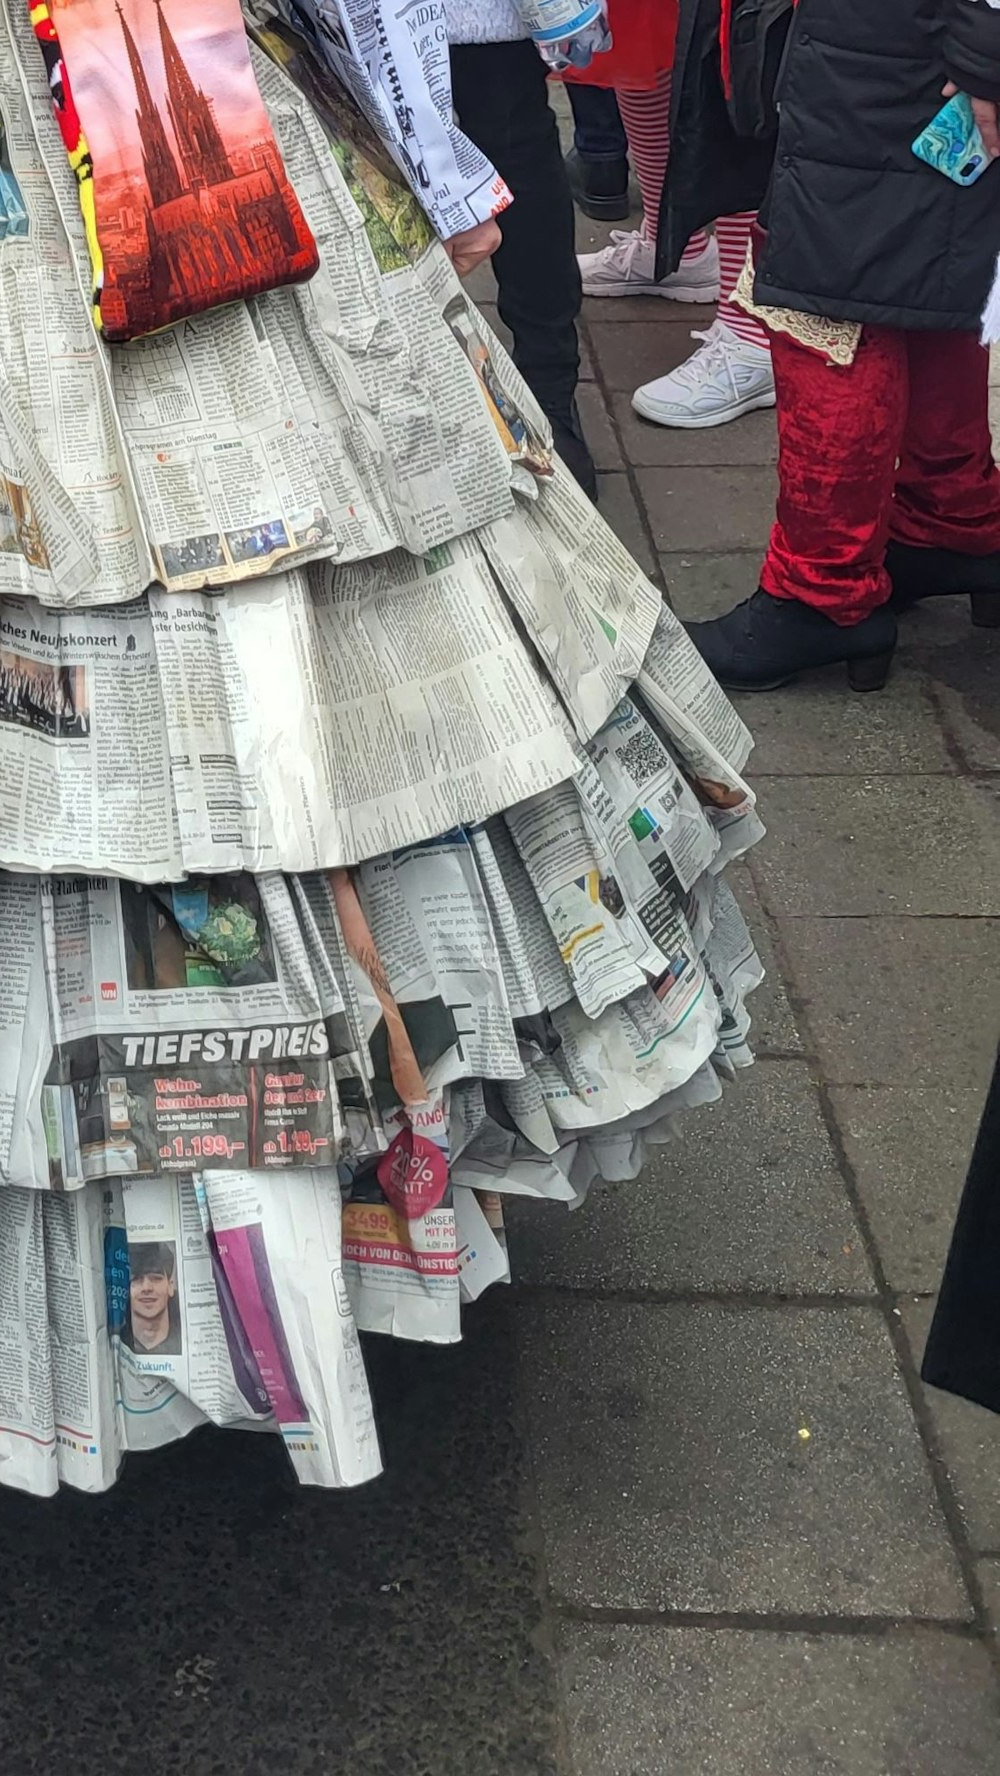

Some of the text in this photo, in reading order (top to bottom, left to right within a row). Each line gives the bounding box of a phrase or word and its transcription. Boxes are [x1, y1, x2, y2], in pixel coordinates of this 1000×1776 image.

[101, 989, 118, 1001] WN
[121, 1022, 330, 1067] TIEFSTPREIS
[154, 1077, 202, 1094] Wohn-
[155, 1093, 248, 1110] kombination
[425, 1227, 441, 1237] MIT
[369, 1246, 392, 1260] VON
